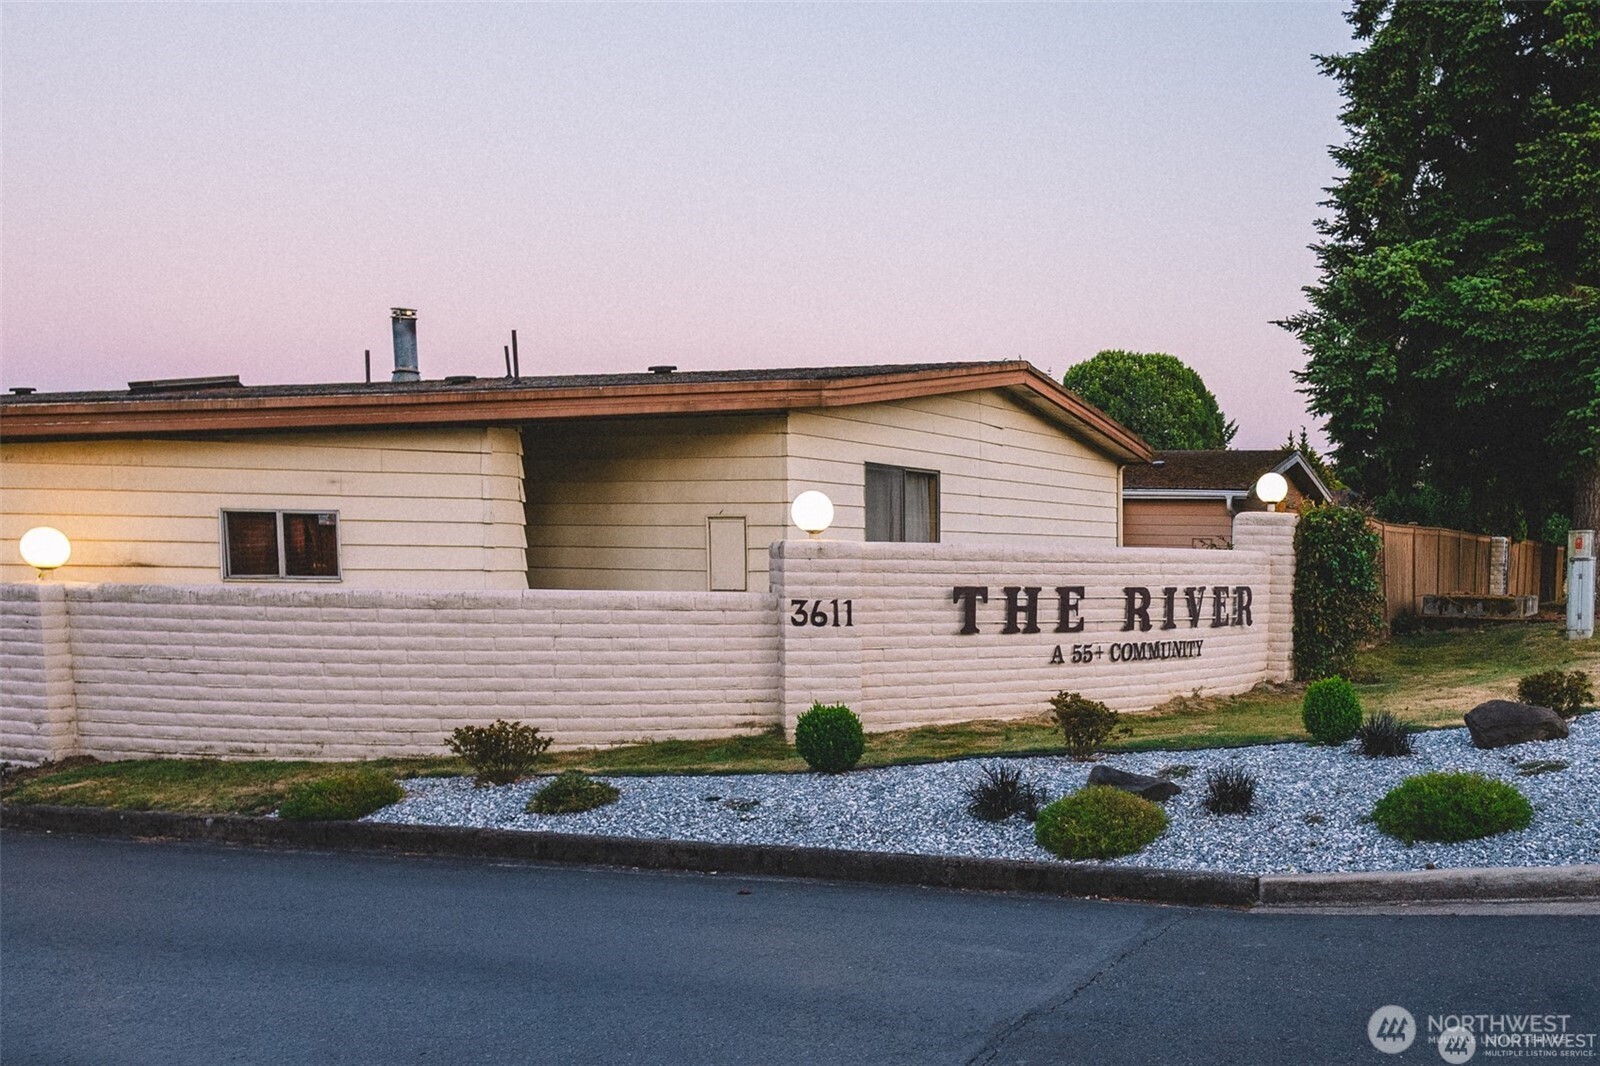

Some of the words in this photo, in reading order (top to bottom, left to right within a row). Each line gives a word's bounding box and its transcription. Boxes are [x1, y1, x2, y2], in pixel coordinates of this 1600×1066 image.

[790, 599, 853, 627] 3611
[952, 586, 1085, 635] THE
[1120, 586, 1253, 632] RIVER
[1050, 645, 1065, 664] A
[1071, 644, 1104, 663] 55+
[1110, 640, 1203, 662] COMMUNITY
